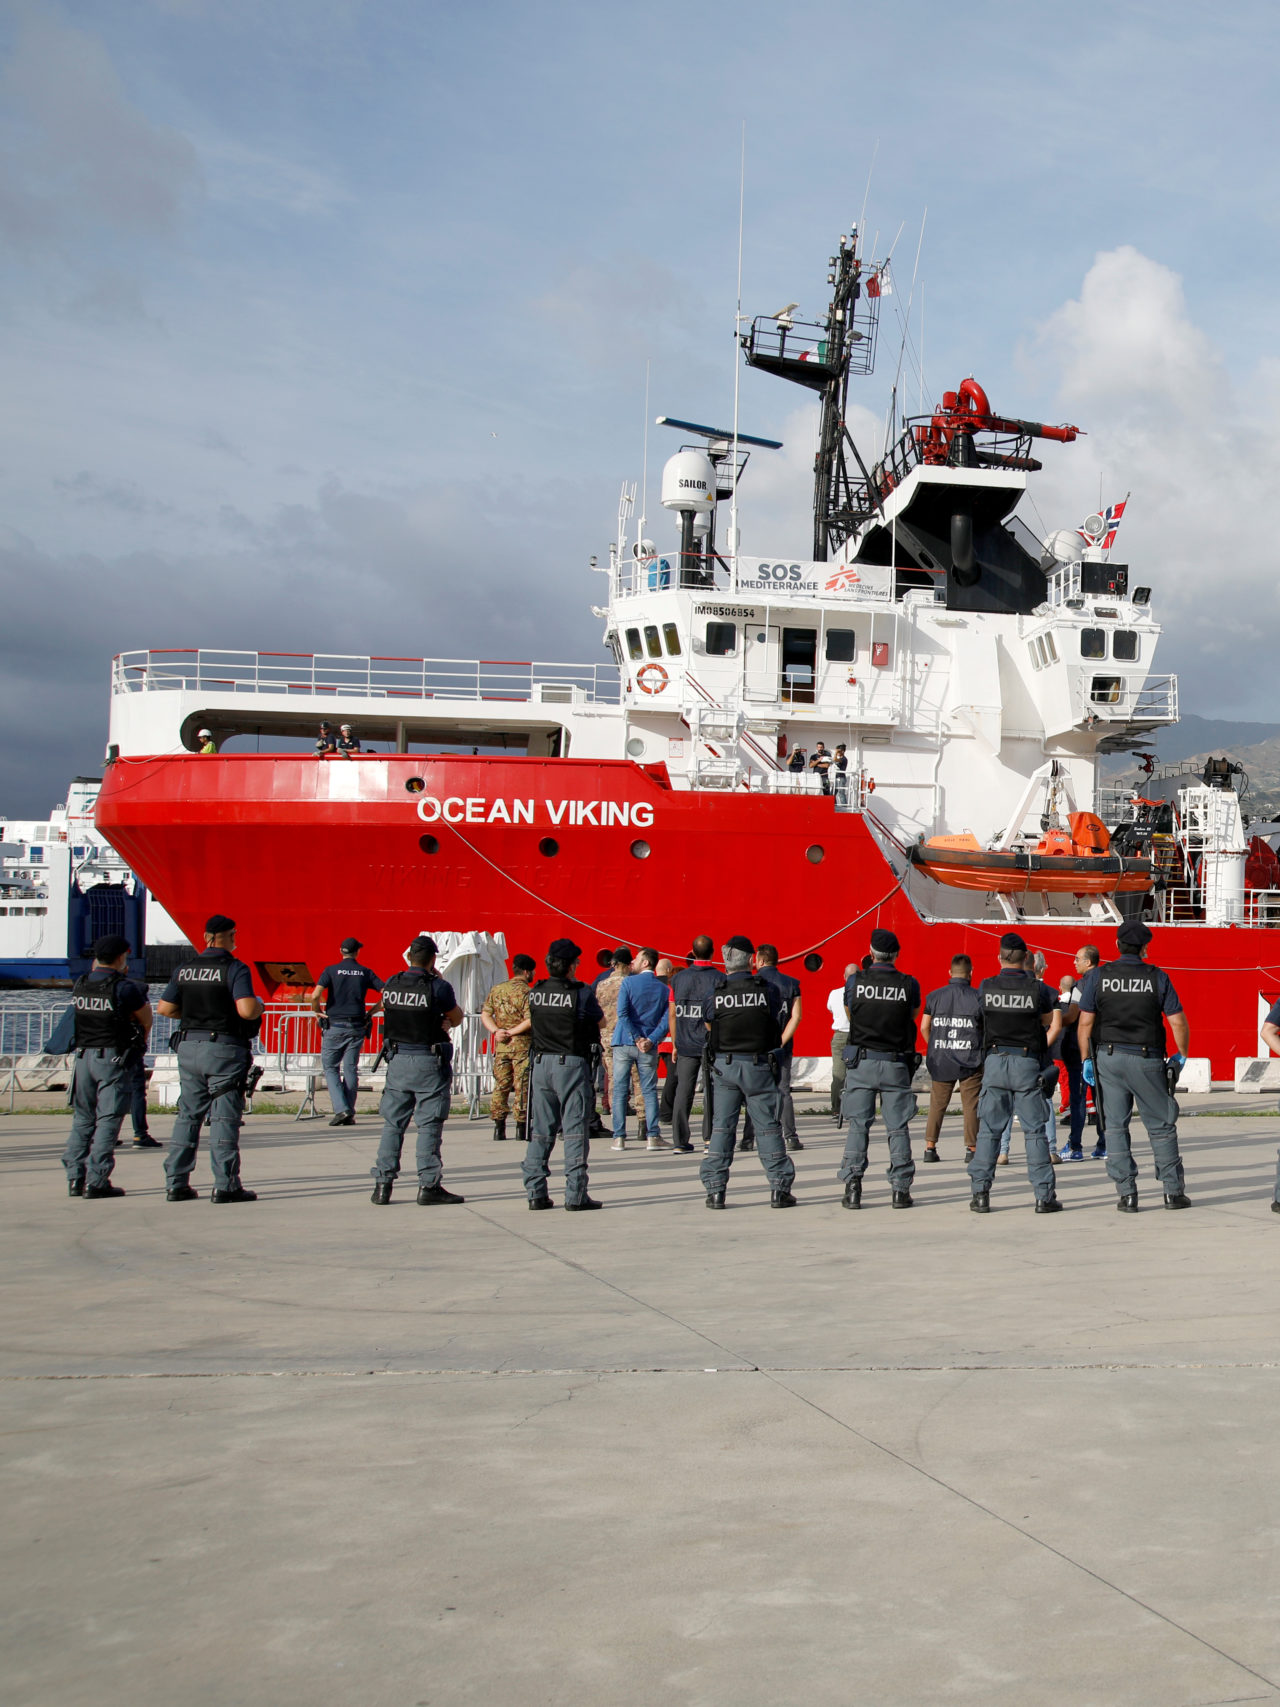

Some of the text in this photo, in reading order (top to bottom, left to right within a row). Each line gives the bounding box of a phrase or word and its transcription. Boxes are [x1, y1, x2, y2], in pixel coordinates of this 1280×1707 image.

[678, 479, 707, 490] SAILOR
[758, 563, 802, 582] SOS
[740, 579, 819, 591] MEDITERRANEE
[417, 797, 655, 827] OCEAN VIKING
[178, 968, 221, 982] POLIZIA
[856, 984, 907, 1001] POLIZIA
[1102, 978, 1153, 993] POLIZIA
[71, 996, 113, 1011] POLIZIA
[382, 990, 428, 1008] POLIZIA
[529, 991, 573, 1008] POLIZIA
[715, 992, 767, 1009] POLIZIA
[985, 993, 1034, 1009] POLIZIA
[675, 1004, 703, 1018] OLIZI
[933, 1017, 973, 1028] GUARDIA
[948, 1029, 957, 1039] di
